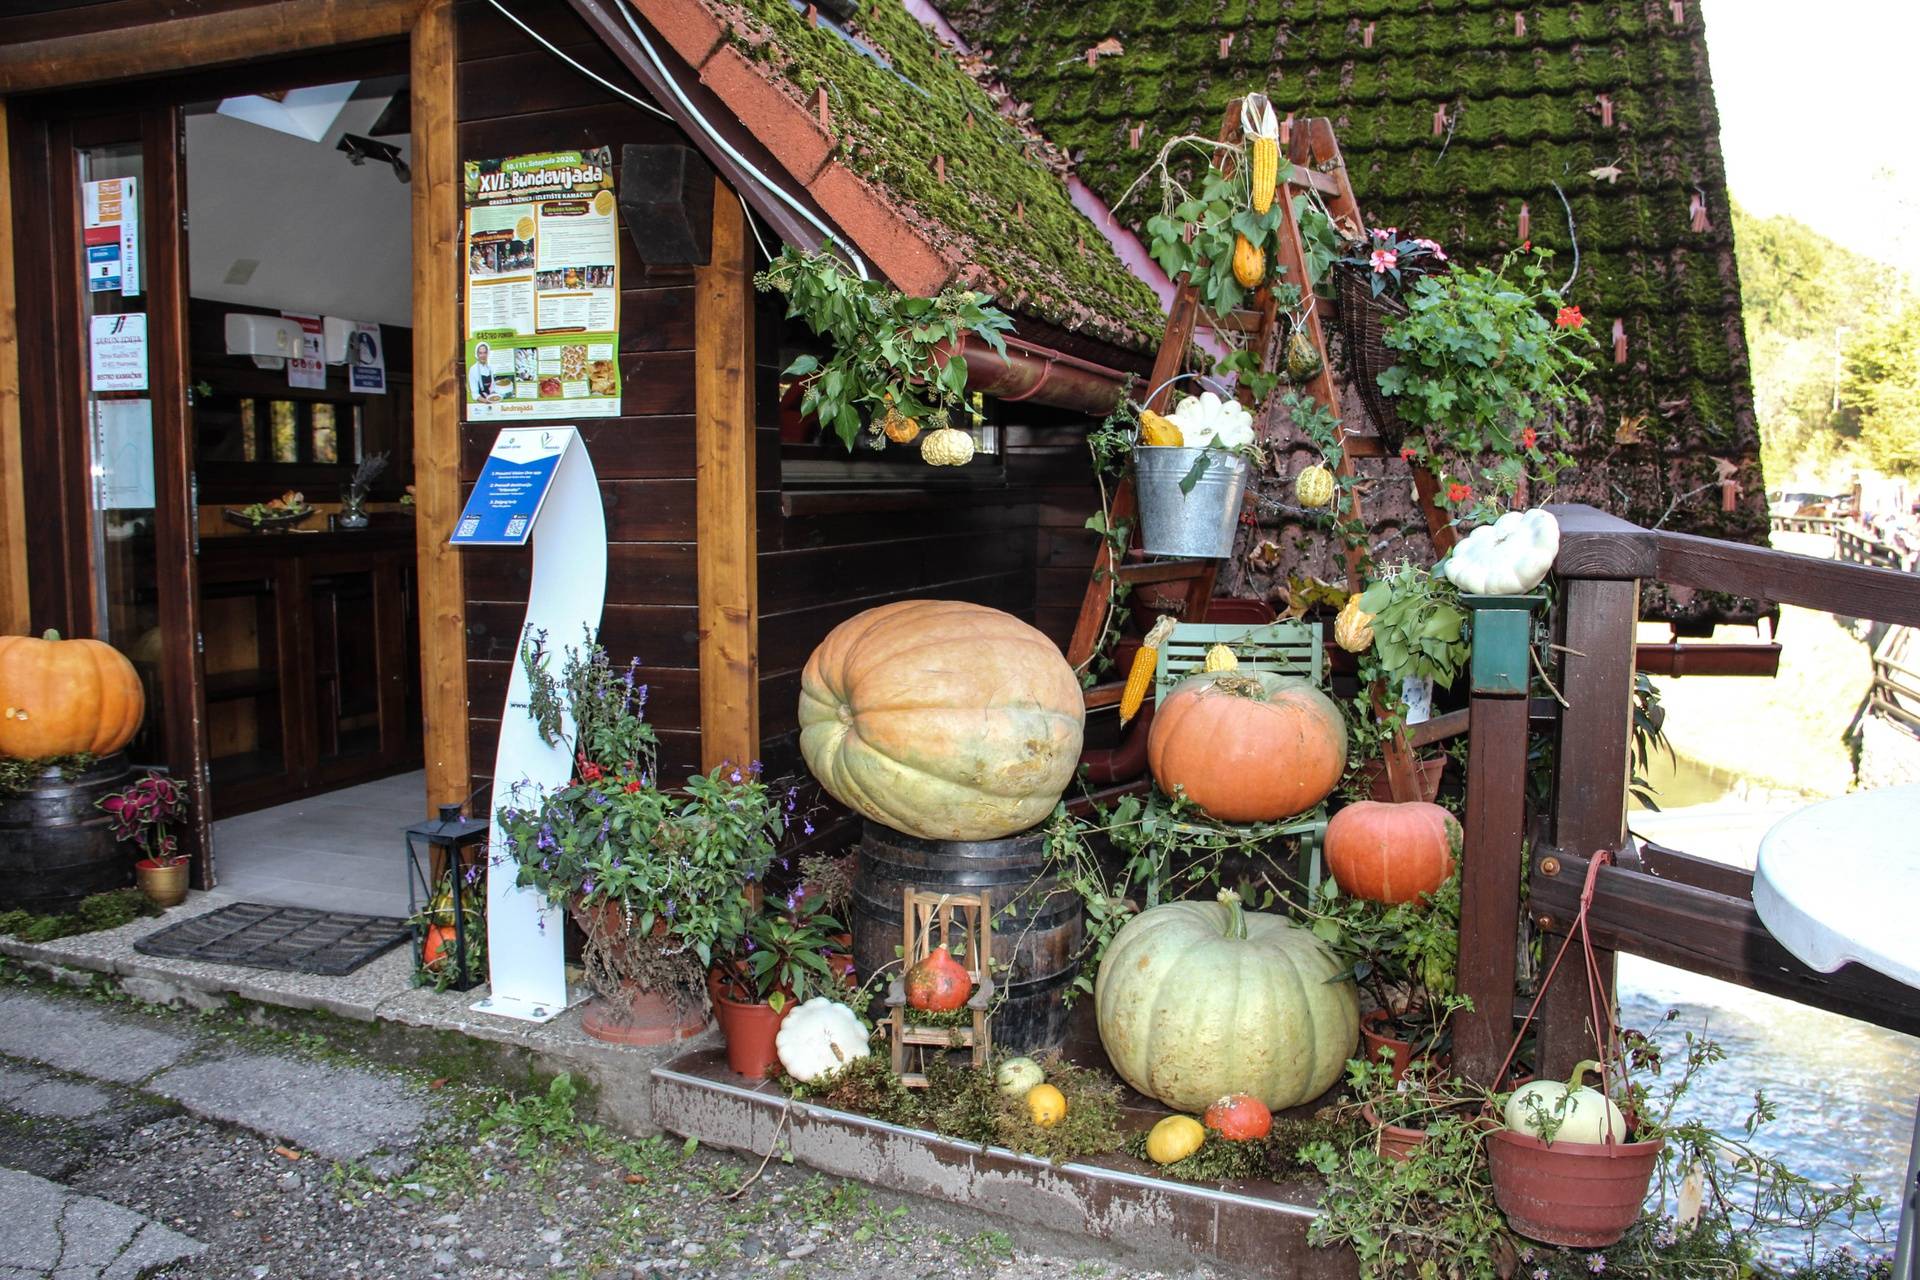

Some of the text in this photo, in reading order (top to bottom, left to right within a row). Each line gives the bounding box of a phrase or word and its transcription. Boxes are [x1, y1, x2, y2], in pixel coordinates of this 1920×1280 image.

[556, 155, 577, 163] 2020.
[480, 172, 510, 192] XVI.
[512, 166, 603, 189] Bundevijada
